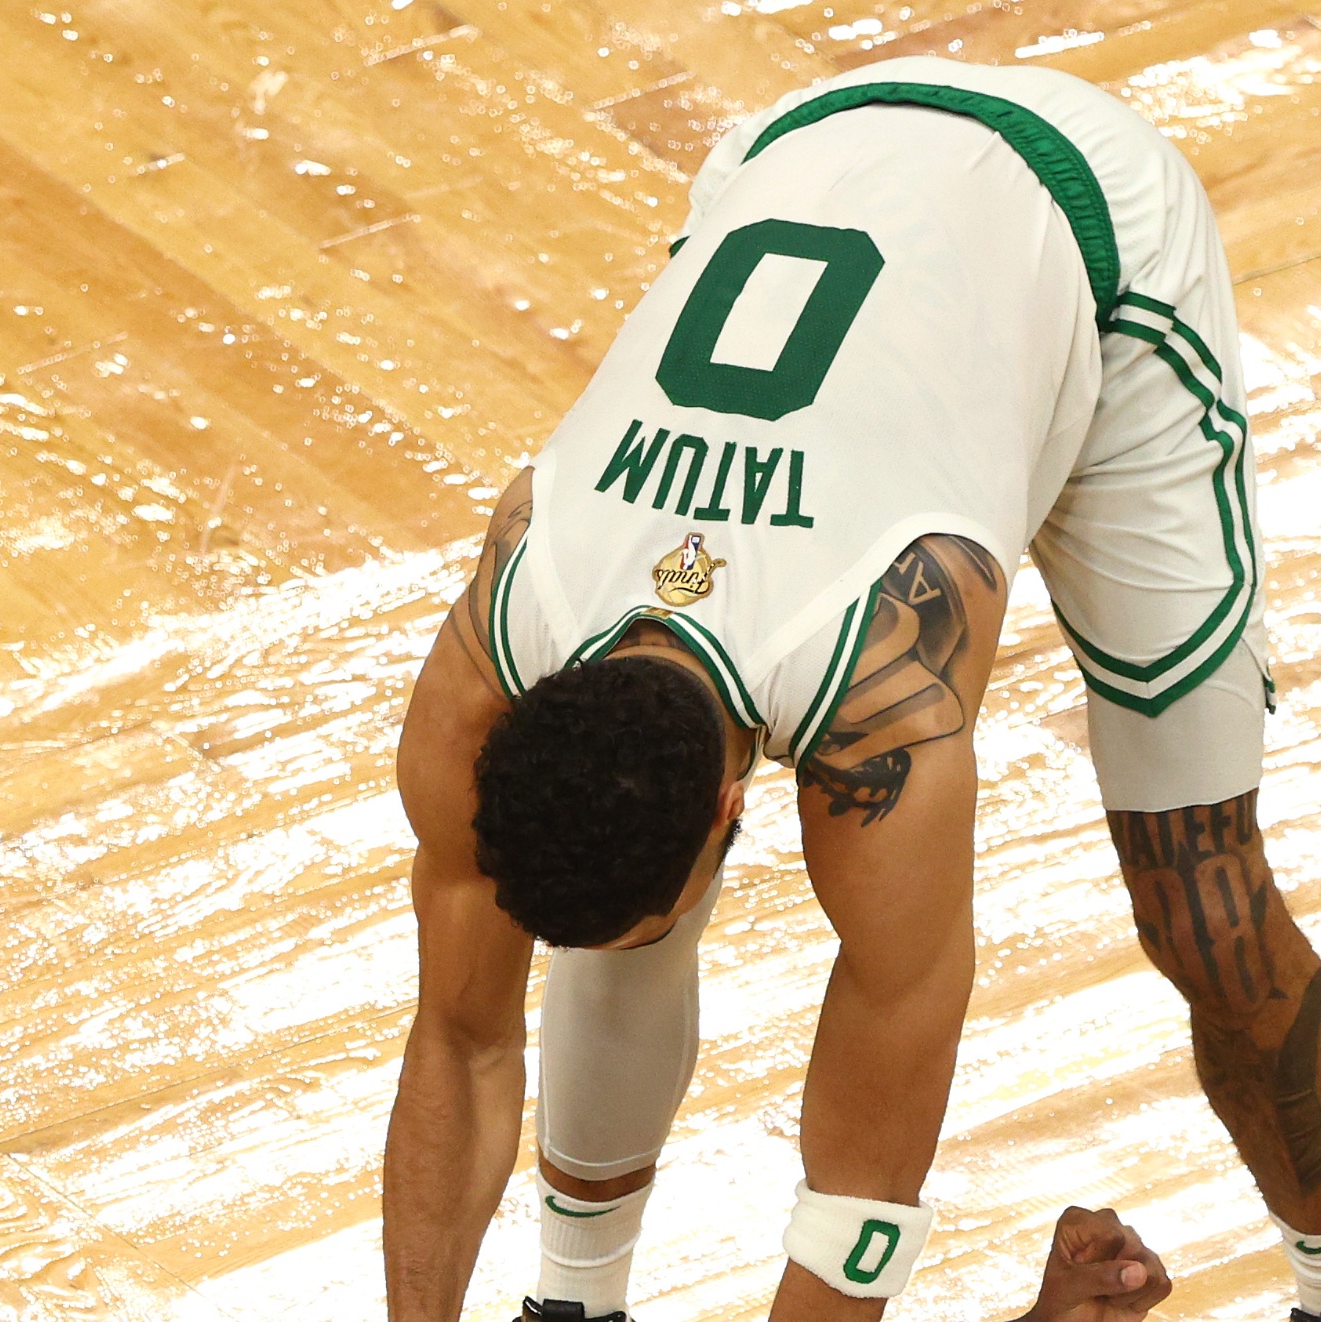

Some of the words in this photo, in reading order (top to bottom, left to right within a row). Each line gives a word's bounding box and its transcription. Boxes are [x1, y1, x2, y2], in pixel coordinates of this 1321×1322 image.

[655, 218, 886, 421] 0
[594, 418, 814, 529] TATUM
[654, 562, 716, 594] Finals
[843, 1218, 901, 1284] 0
